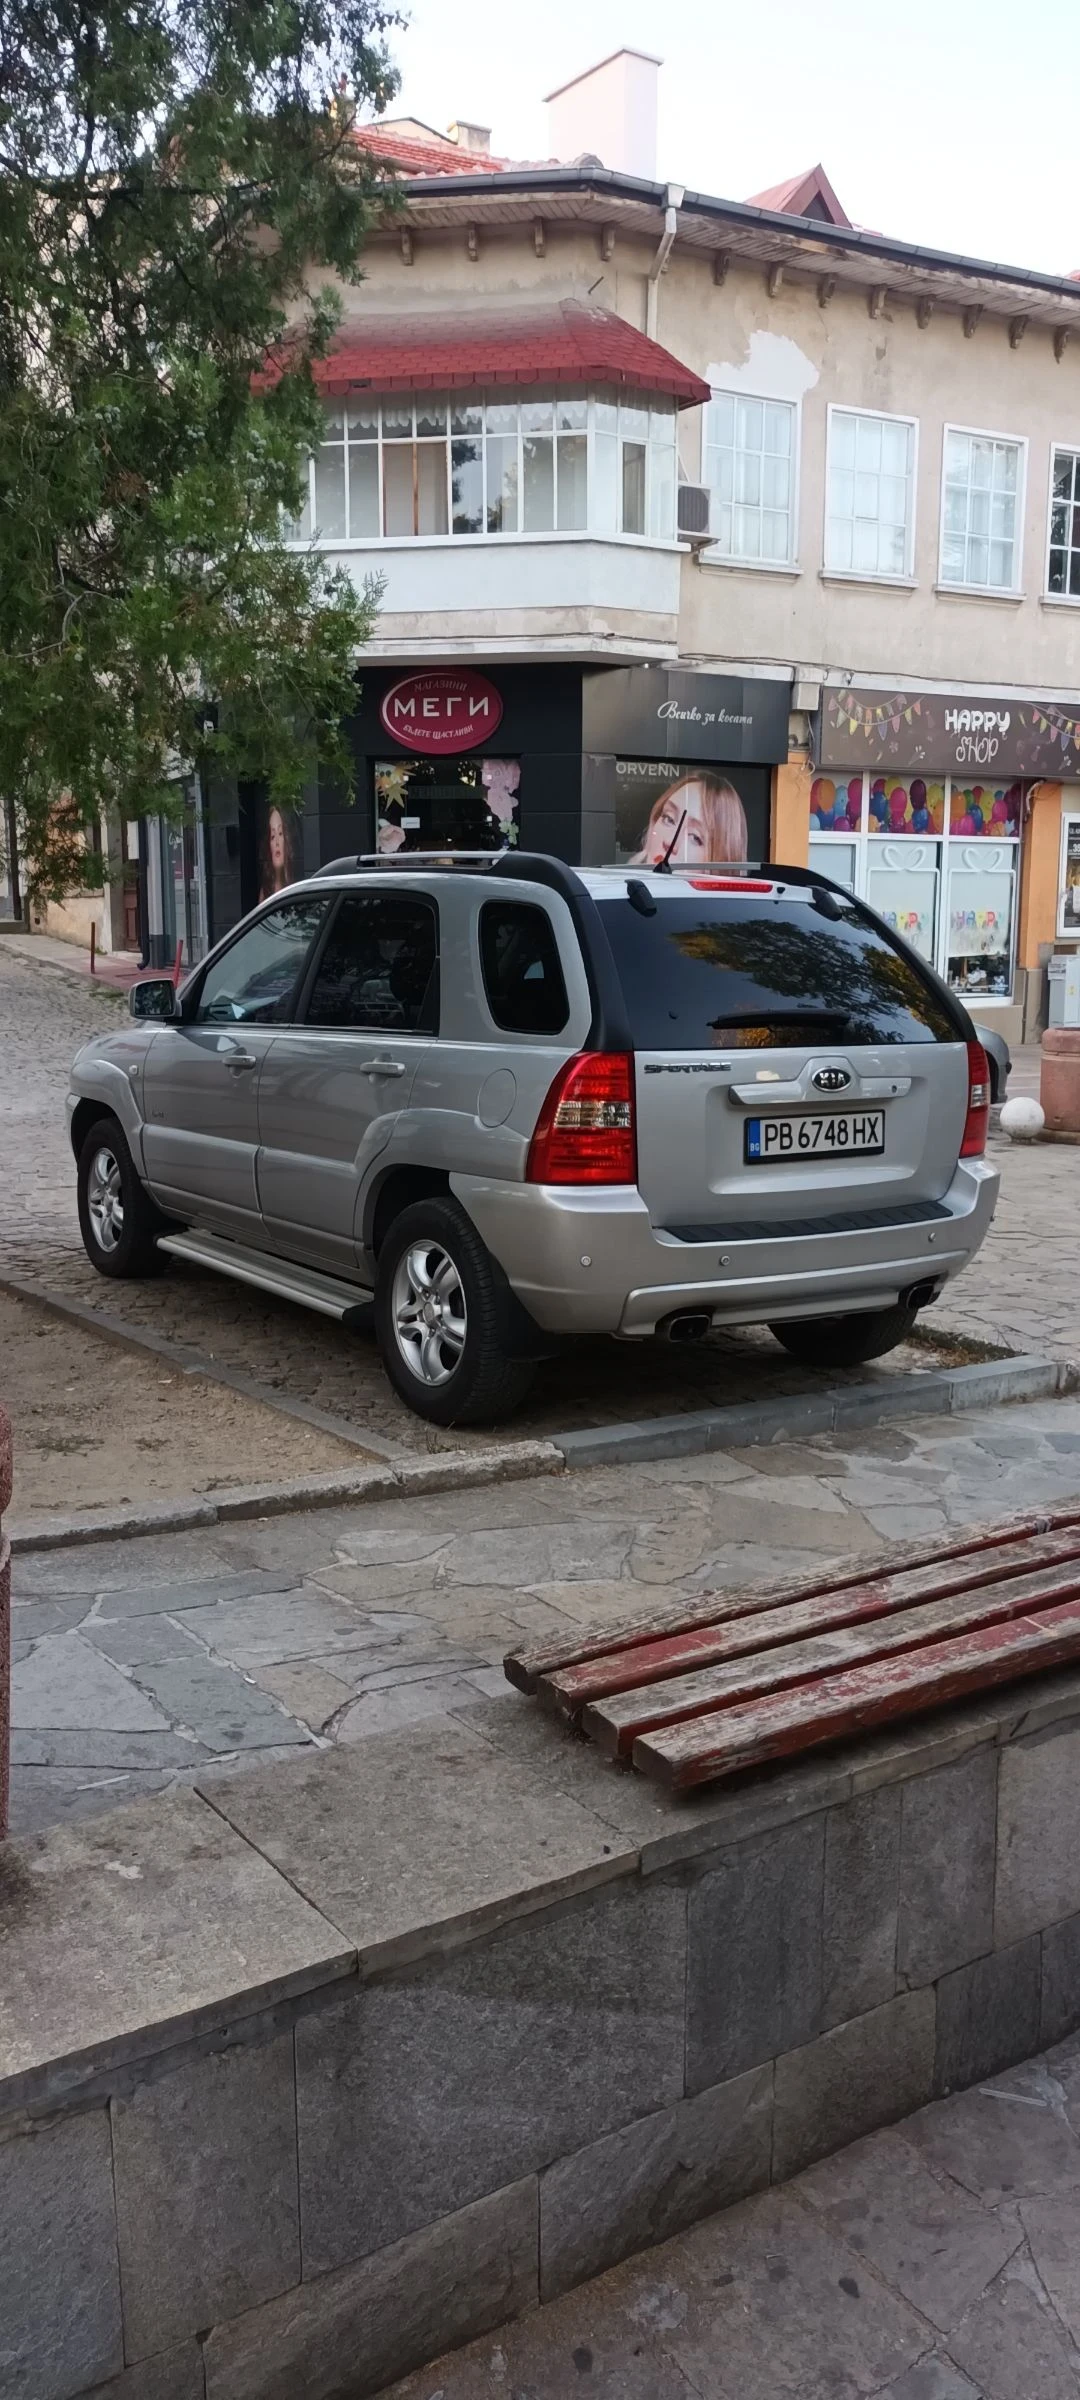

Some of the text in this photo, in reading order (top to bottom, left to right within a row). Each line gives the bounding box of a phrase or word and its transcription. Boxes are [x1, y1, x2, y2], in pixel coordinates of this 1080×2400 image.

[414, 680, 468, 692] МАГАЗИНИ
[394, 697, 489, 717] МЕГИ
[657, 701, 753, 726] Всичко за косата
[944, 708, 1011, 734] HAPPY
[432, 724, 474, 740] ЩАСТЛИВИ
[955, 736, 999, 763] SHOP
[644, 1062, 732, 1074] SPORTAGE
[819, 1072, 847, 1087] KIA
[764, 1116, 879, 1152] PB 6748 HX
[749, 1142, 760, 1152] BG
